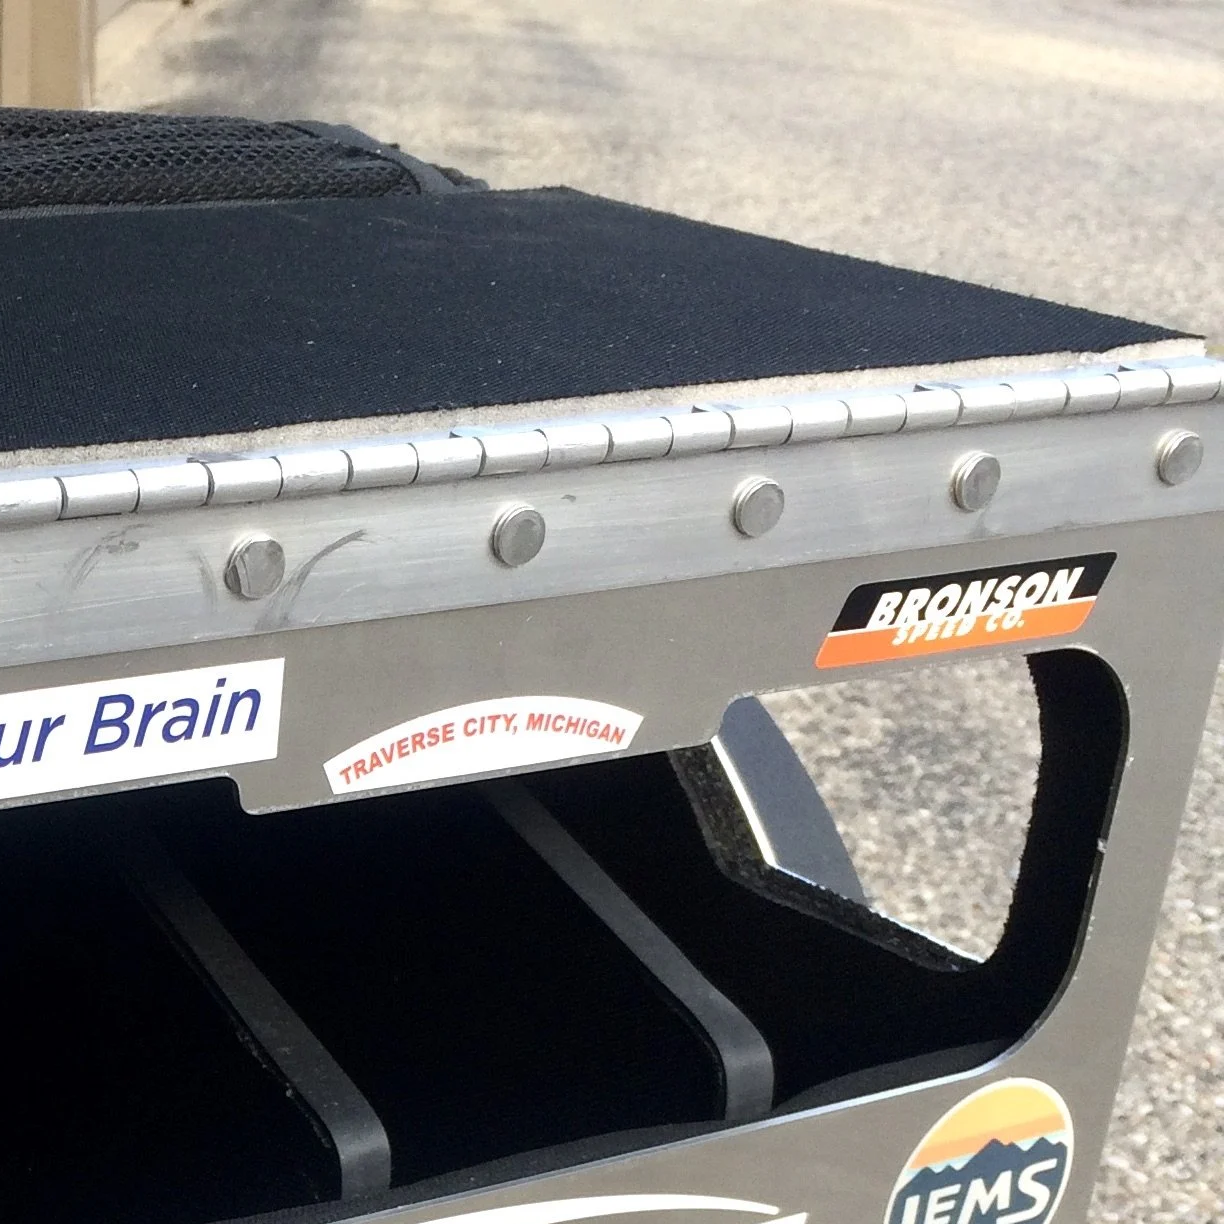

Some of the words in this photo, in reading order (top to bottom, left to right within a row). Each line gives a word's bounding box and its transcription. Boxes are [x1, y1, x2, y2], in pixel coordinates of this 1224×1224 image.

[866, 567, 1085, 629] BRONSON
[82, 677, 261, 755] Brain
[339, 722, 456, 786] TRAVERSE
[463, 713, 518, 737] CITY,
[525, 713, 627, 745] MICHIGAN
